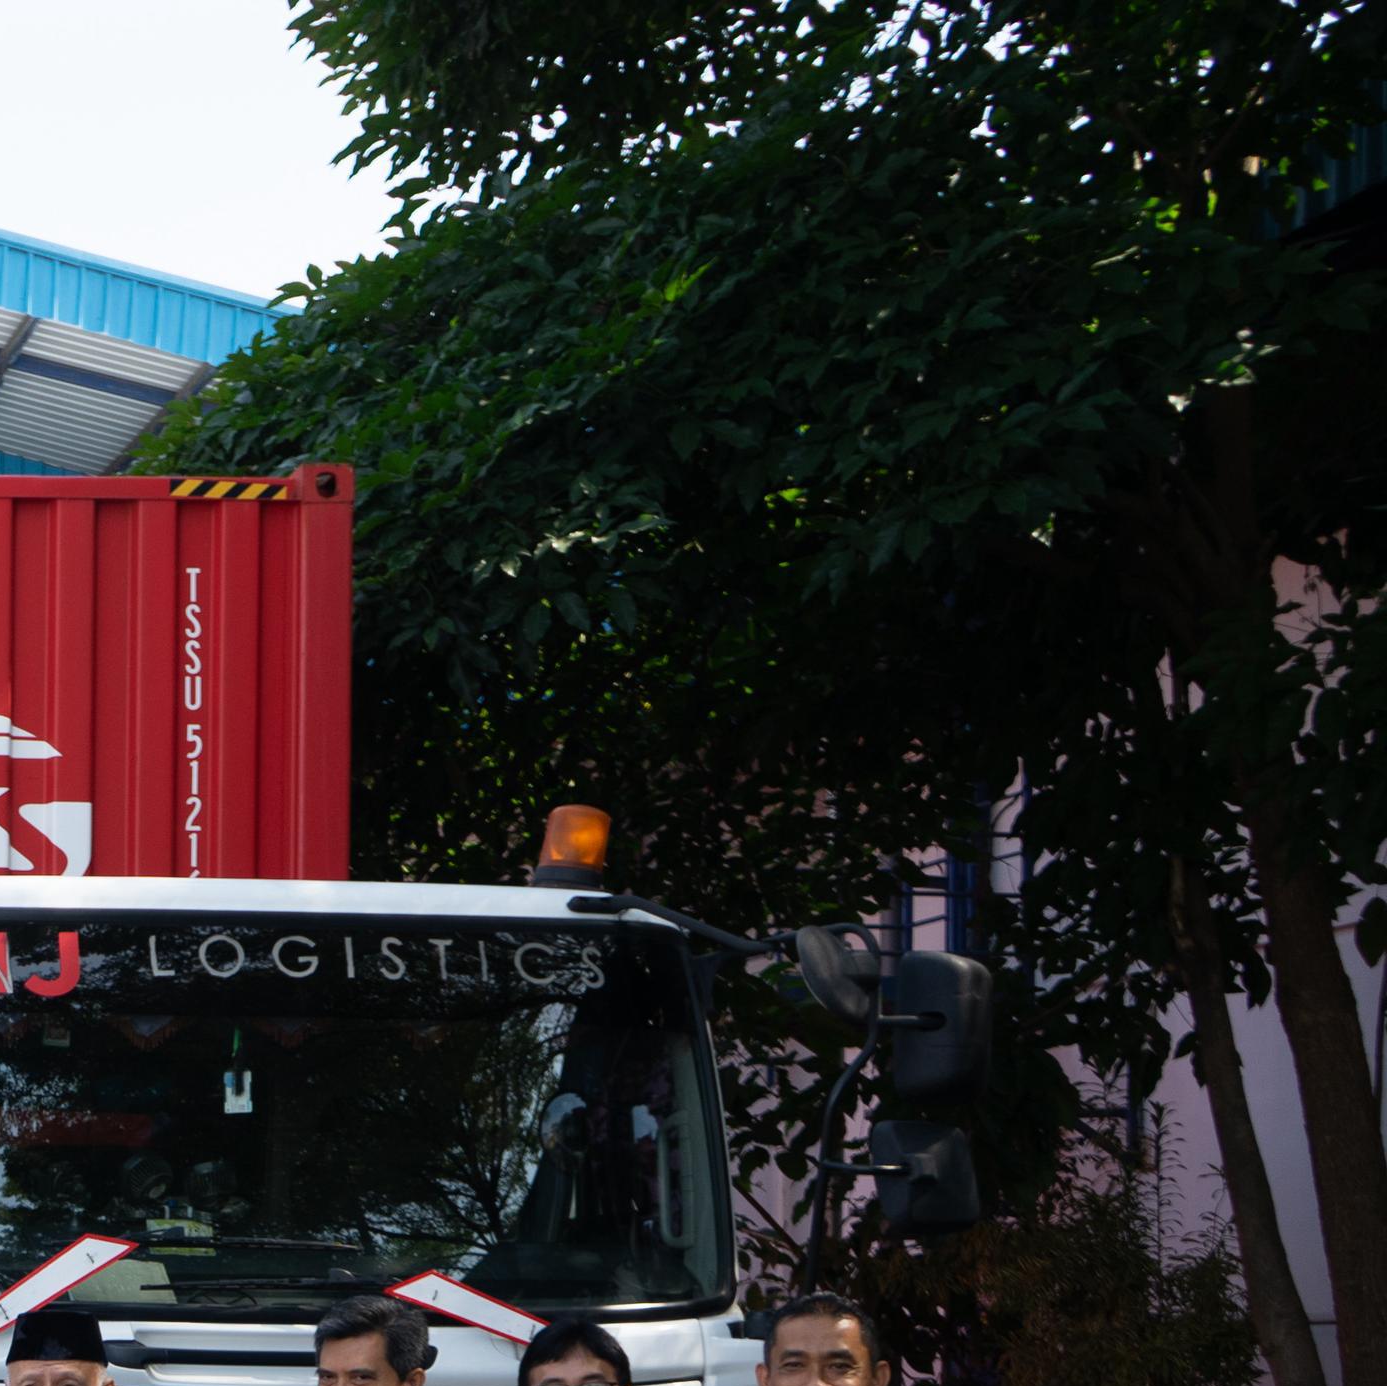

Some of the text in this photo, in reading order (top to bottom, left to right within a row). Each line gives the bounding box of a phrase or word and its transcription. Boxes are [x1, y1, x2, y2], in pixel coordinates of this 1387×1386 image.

[184, 567, 203, 877] TSSU 5121
[148, 934, 606, 989] LOGISTICS
